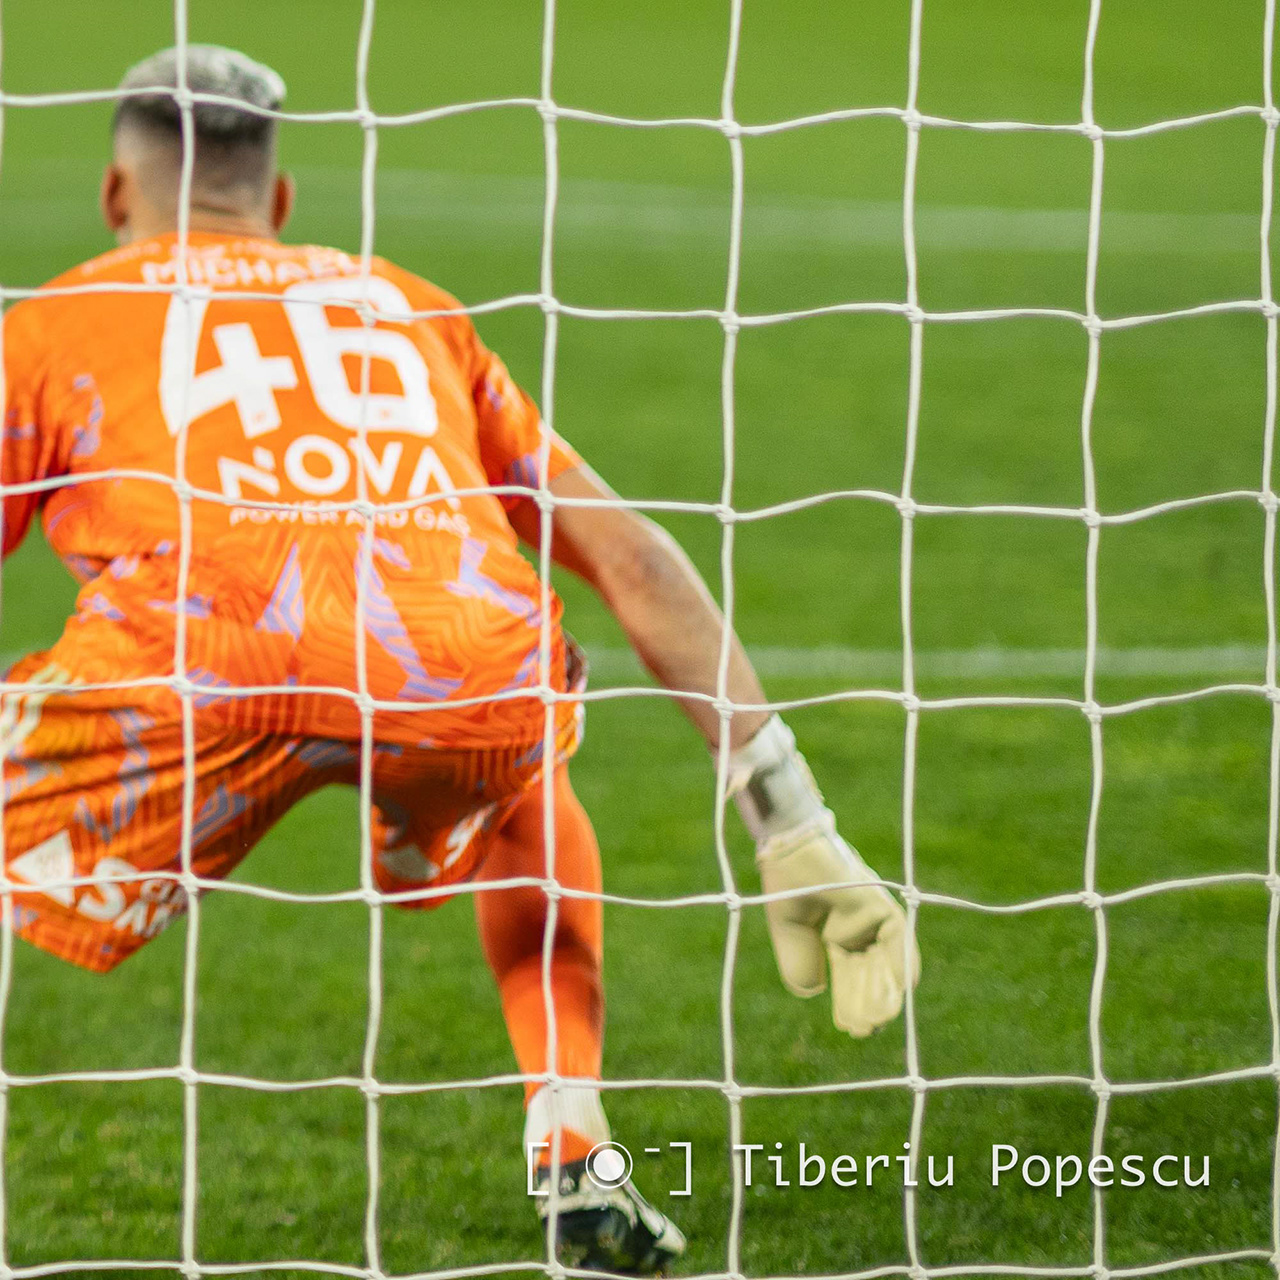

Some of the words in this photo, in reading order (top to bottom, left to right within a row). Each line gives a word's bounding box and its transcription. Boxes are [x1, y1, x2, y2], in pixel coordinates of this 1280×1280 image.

[158, 276, 439, 439] 46
[217, 434, 461, 512] NOVA
[413, 506, 471, 538] GAS
